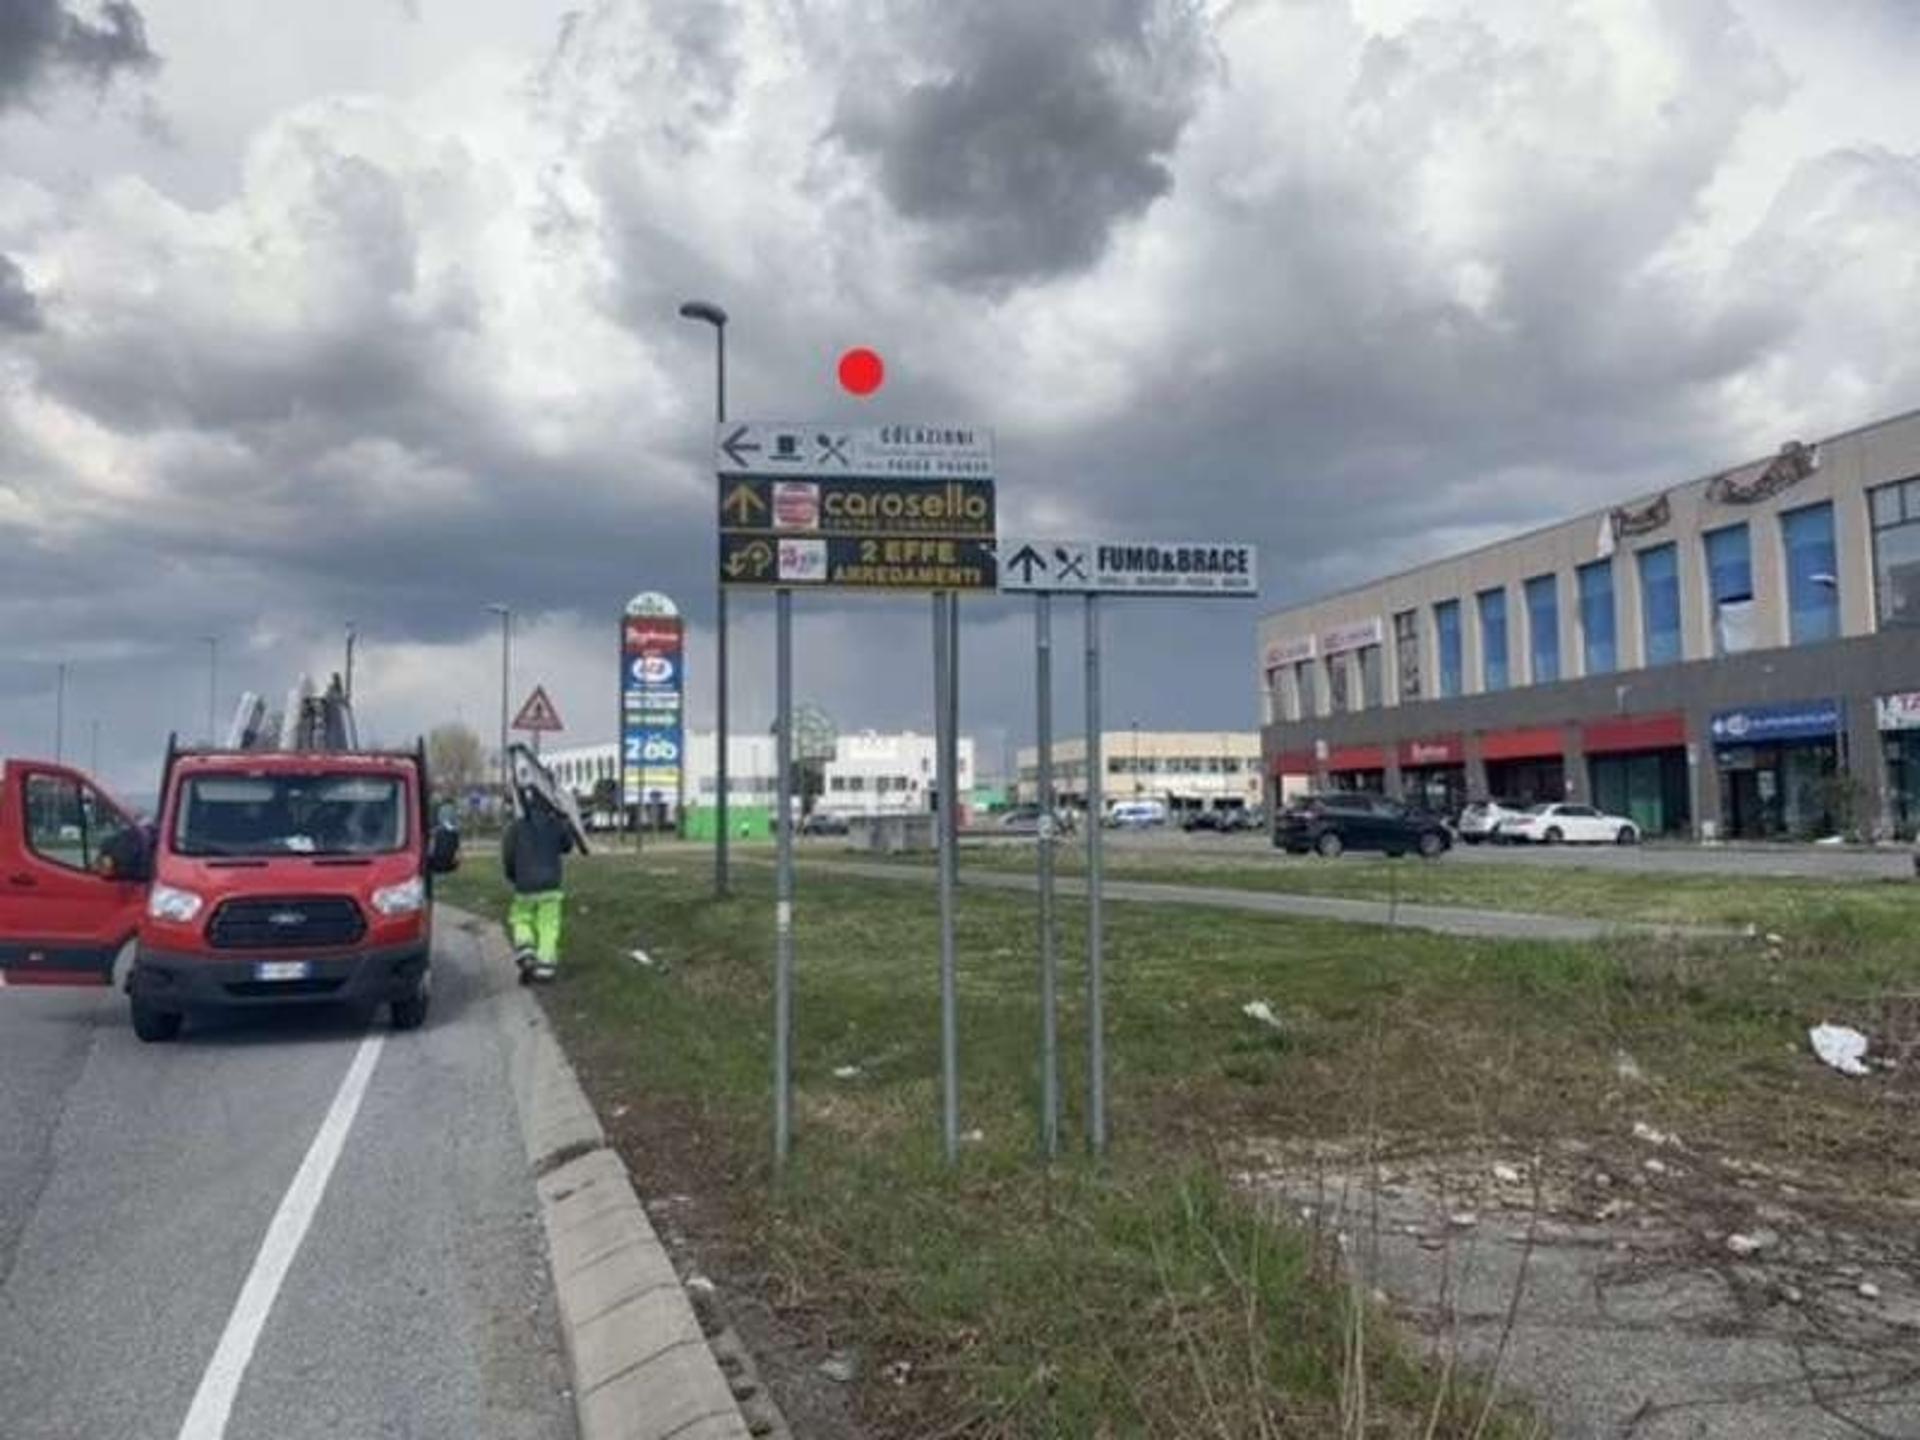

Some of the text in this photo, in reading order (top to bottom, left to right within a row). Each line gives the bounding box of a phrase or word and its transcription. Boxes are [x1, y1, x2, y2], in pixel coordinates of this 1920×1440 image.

[825, 483, 987, 519] carosello
[860, 540, 957, 564] 2 EFFE
[1098, 547, 1249, 574] FUMO&BRACE
[833, 565, 981, 584] ARREDAMENTI
